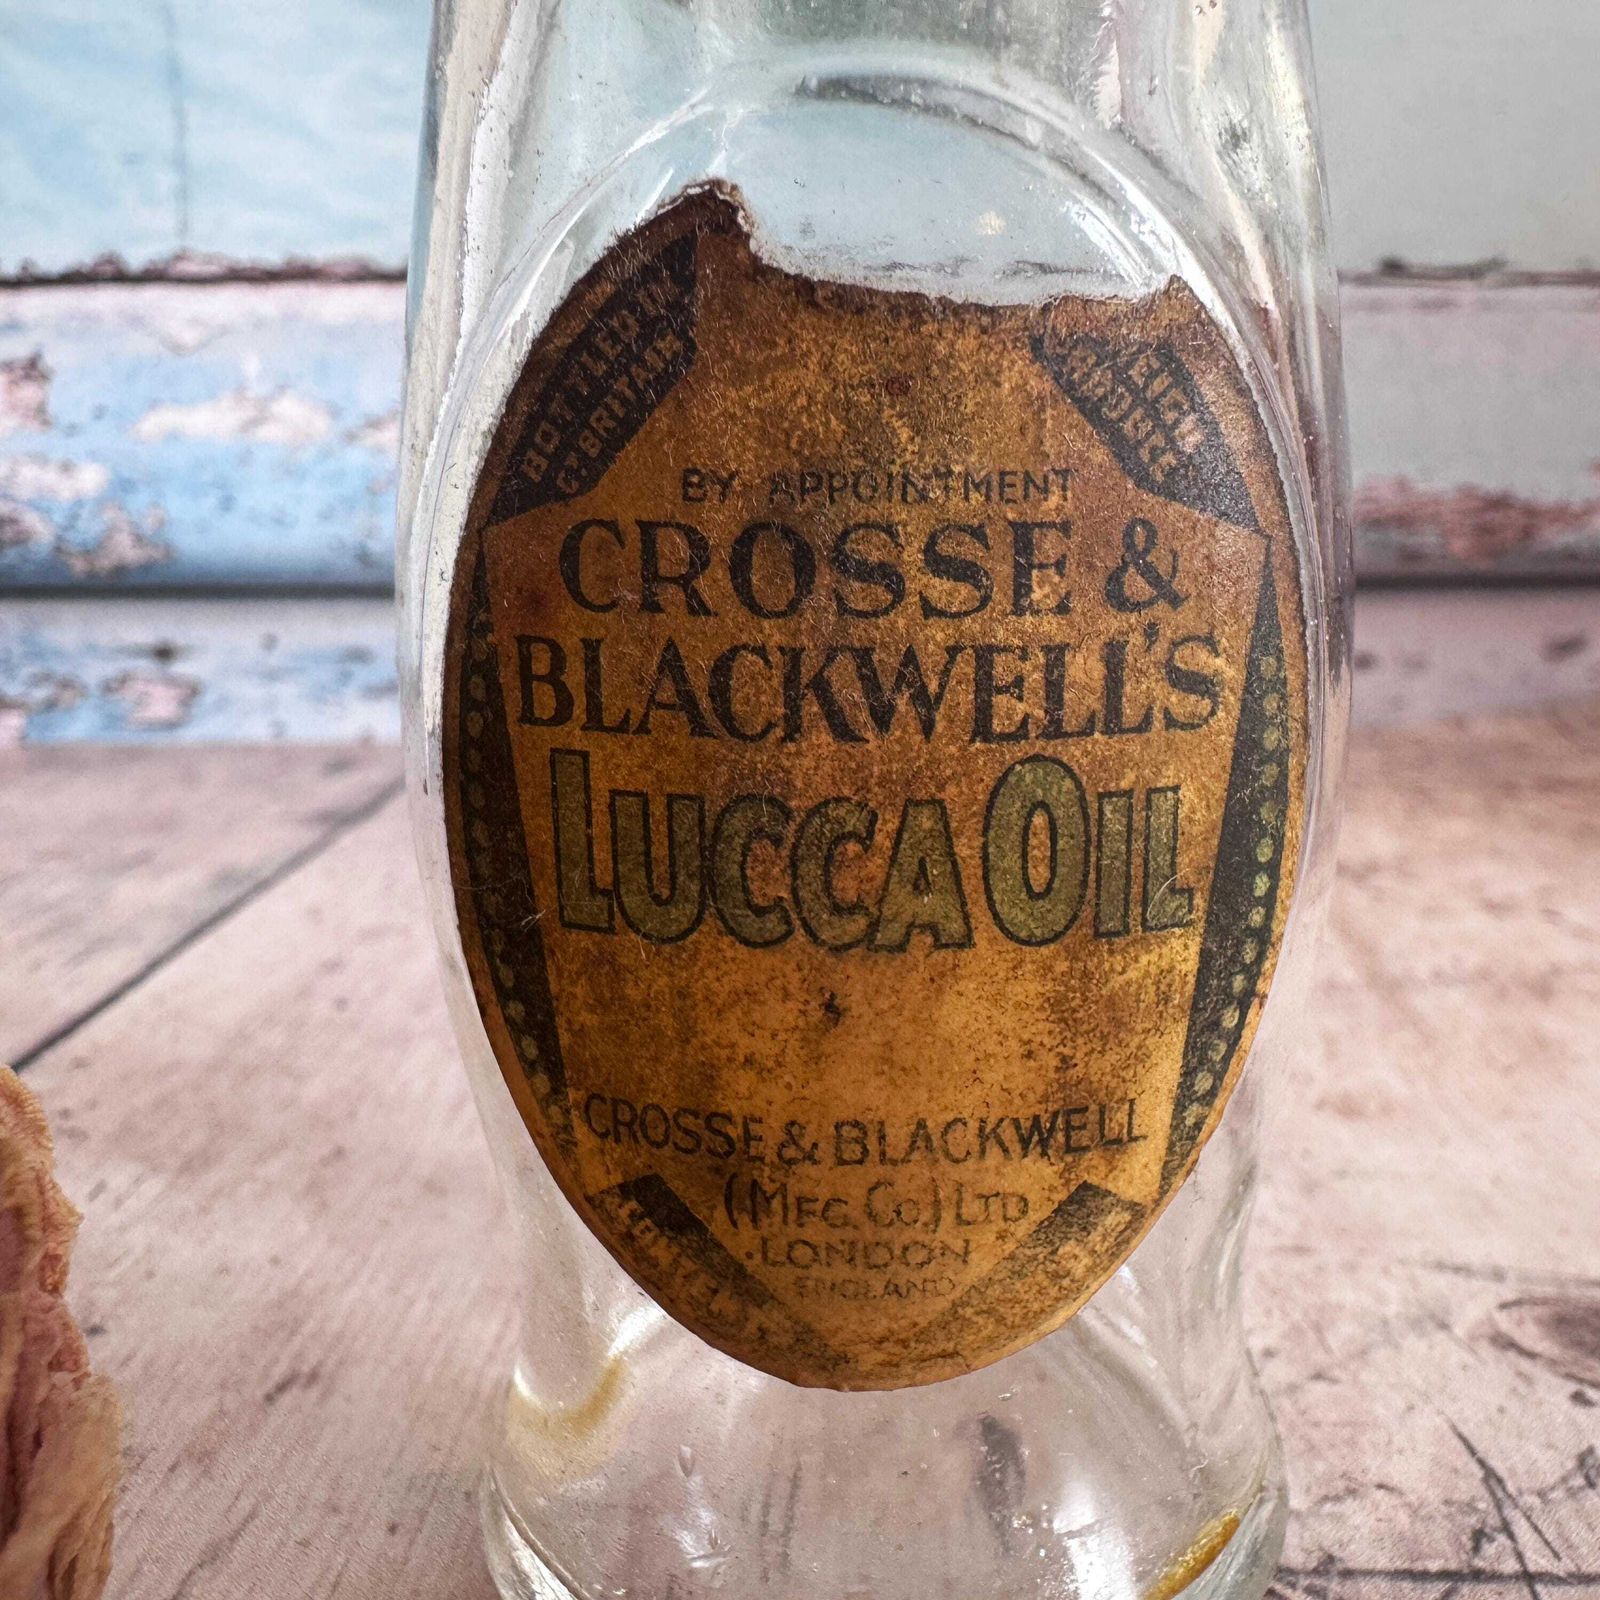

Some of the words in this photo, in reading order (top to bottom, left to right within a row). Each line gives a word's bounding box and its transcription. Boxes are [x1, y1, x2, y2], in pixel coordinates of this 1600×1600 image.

[682, 467, 739, 502] BY
[768, 466, 1077, 503] APPOINTMENT
[558, 518, 1072, 620] CROSSE
[1103, 518, 1189, 614] &
[516, 621, 1225, 746] BLACKWELL'S
[550, 748, 975, 953] LUCCA
[982, 753, 1195, 947] OIL
[584, 1092, 764, 1163] CROSSE
[776, 1119, 822, 1166] &
[833, 1097, 1149, 1167] BLACKWELL
